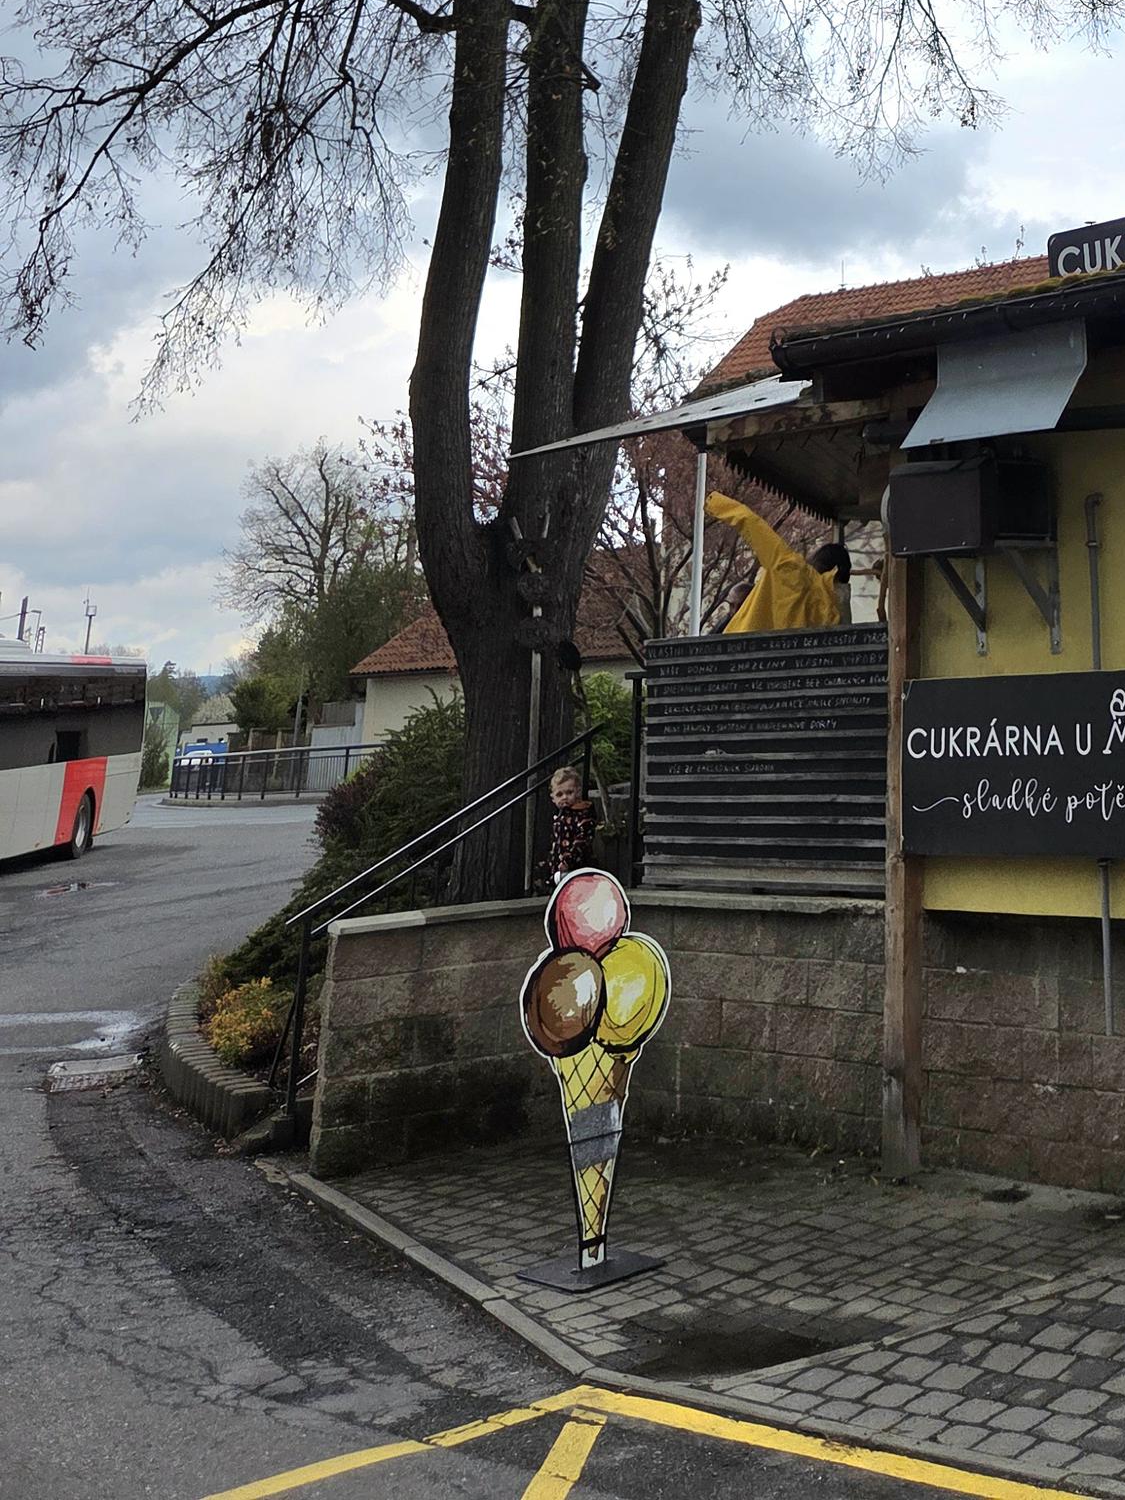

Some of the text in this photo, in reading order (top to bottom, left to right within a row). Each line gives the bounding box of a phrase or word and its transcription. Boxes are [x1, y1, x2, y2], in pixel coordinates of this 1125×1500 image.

[907, 718, 1064, 759] CUKRÁRNA
[1076, 723, 1092, 756] U
[962, 778, 1058, 818] sladké
